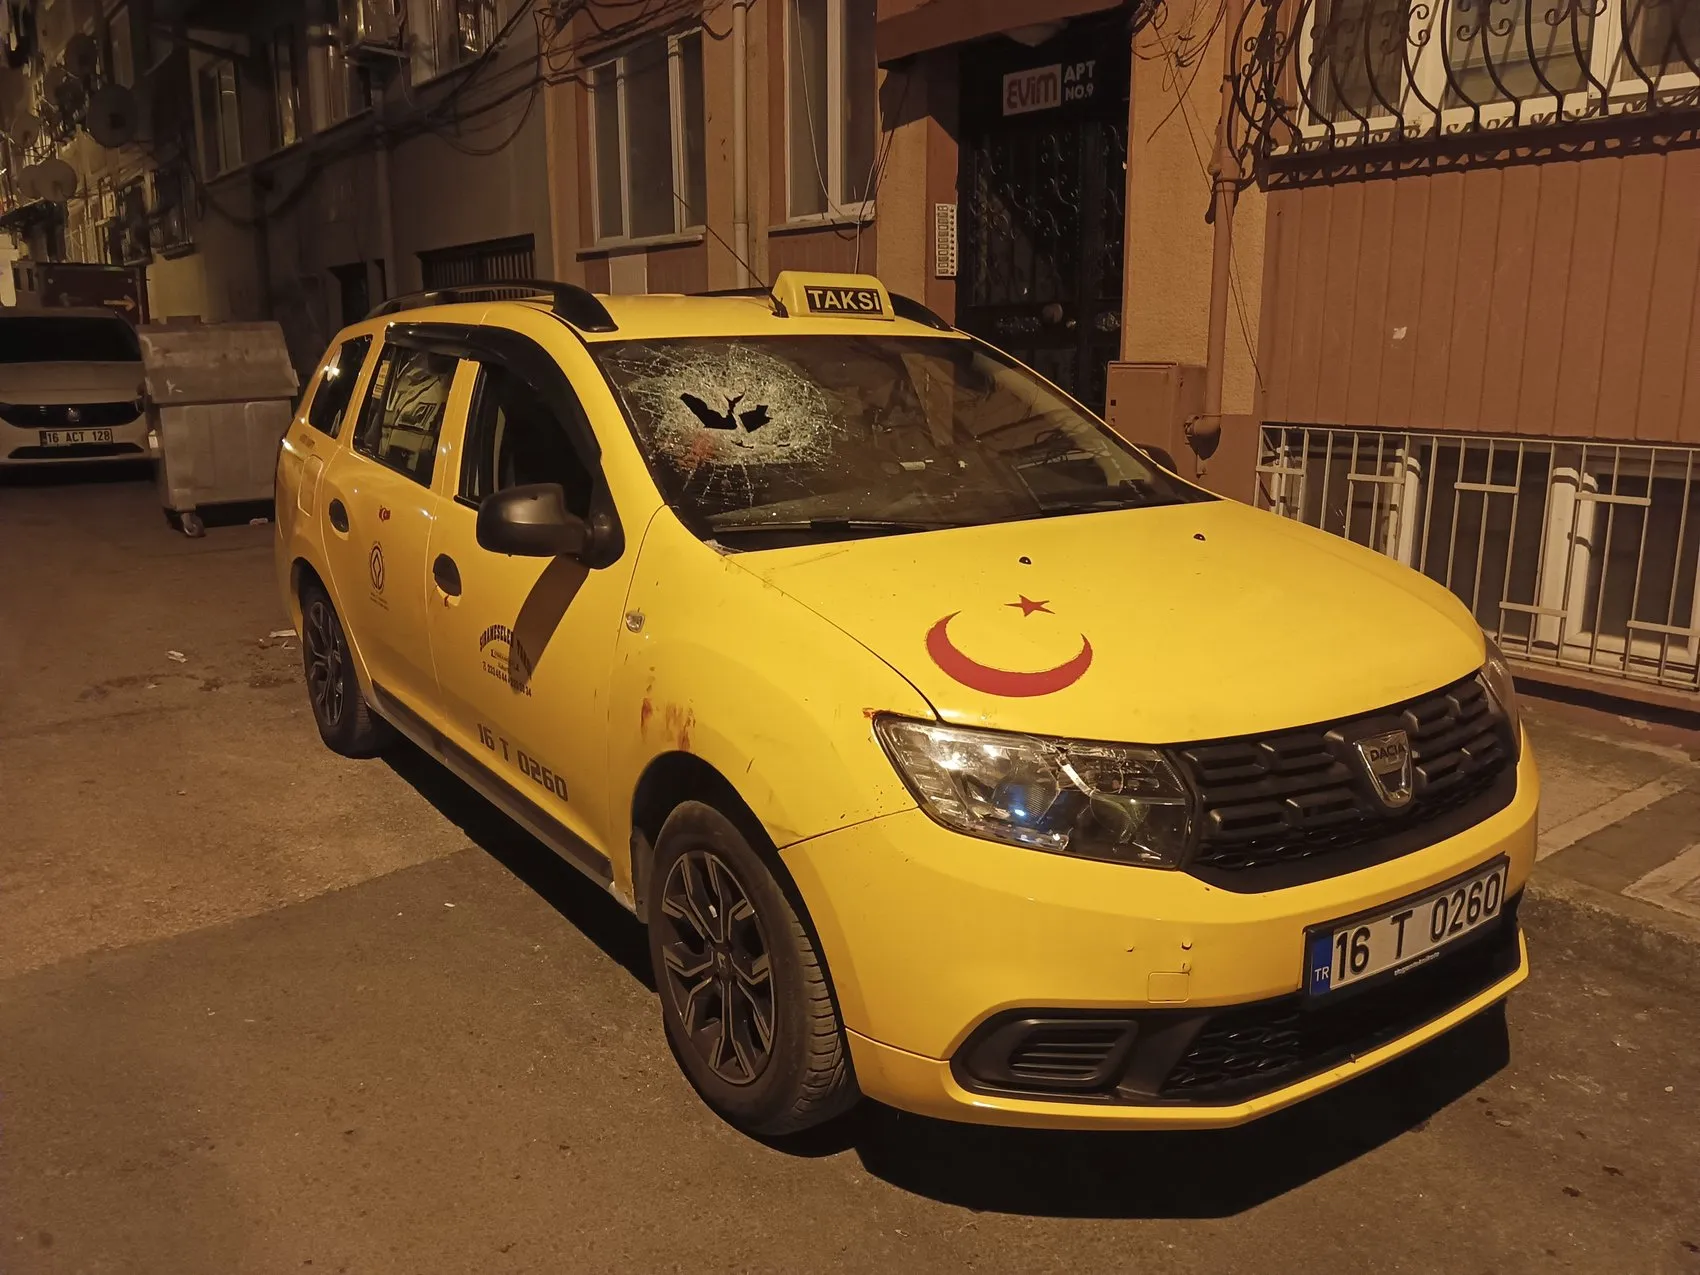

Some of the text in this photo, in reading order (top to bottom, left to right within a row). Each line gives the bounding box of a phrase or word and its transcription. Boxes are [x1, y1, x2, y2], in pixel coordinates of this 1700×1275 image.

[1064, 60, 1096, 83] APT
[47, 431, 111, 443] 16 ACT 128
[1370, 743, 1405, 761] DACIA
[477, 723, 569, 802] 16 T 0260
[1336, 925, 1371, 981] 16
[1389, 909, 1414, 960] T
[1430, 872, 1501, 943] 0260
[1314, 966, 1330, 982] TR
